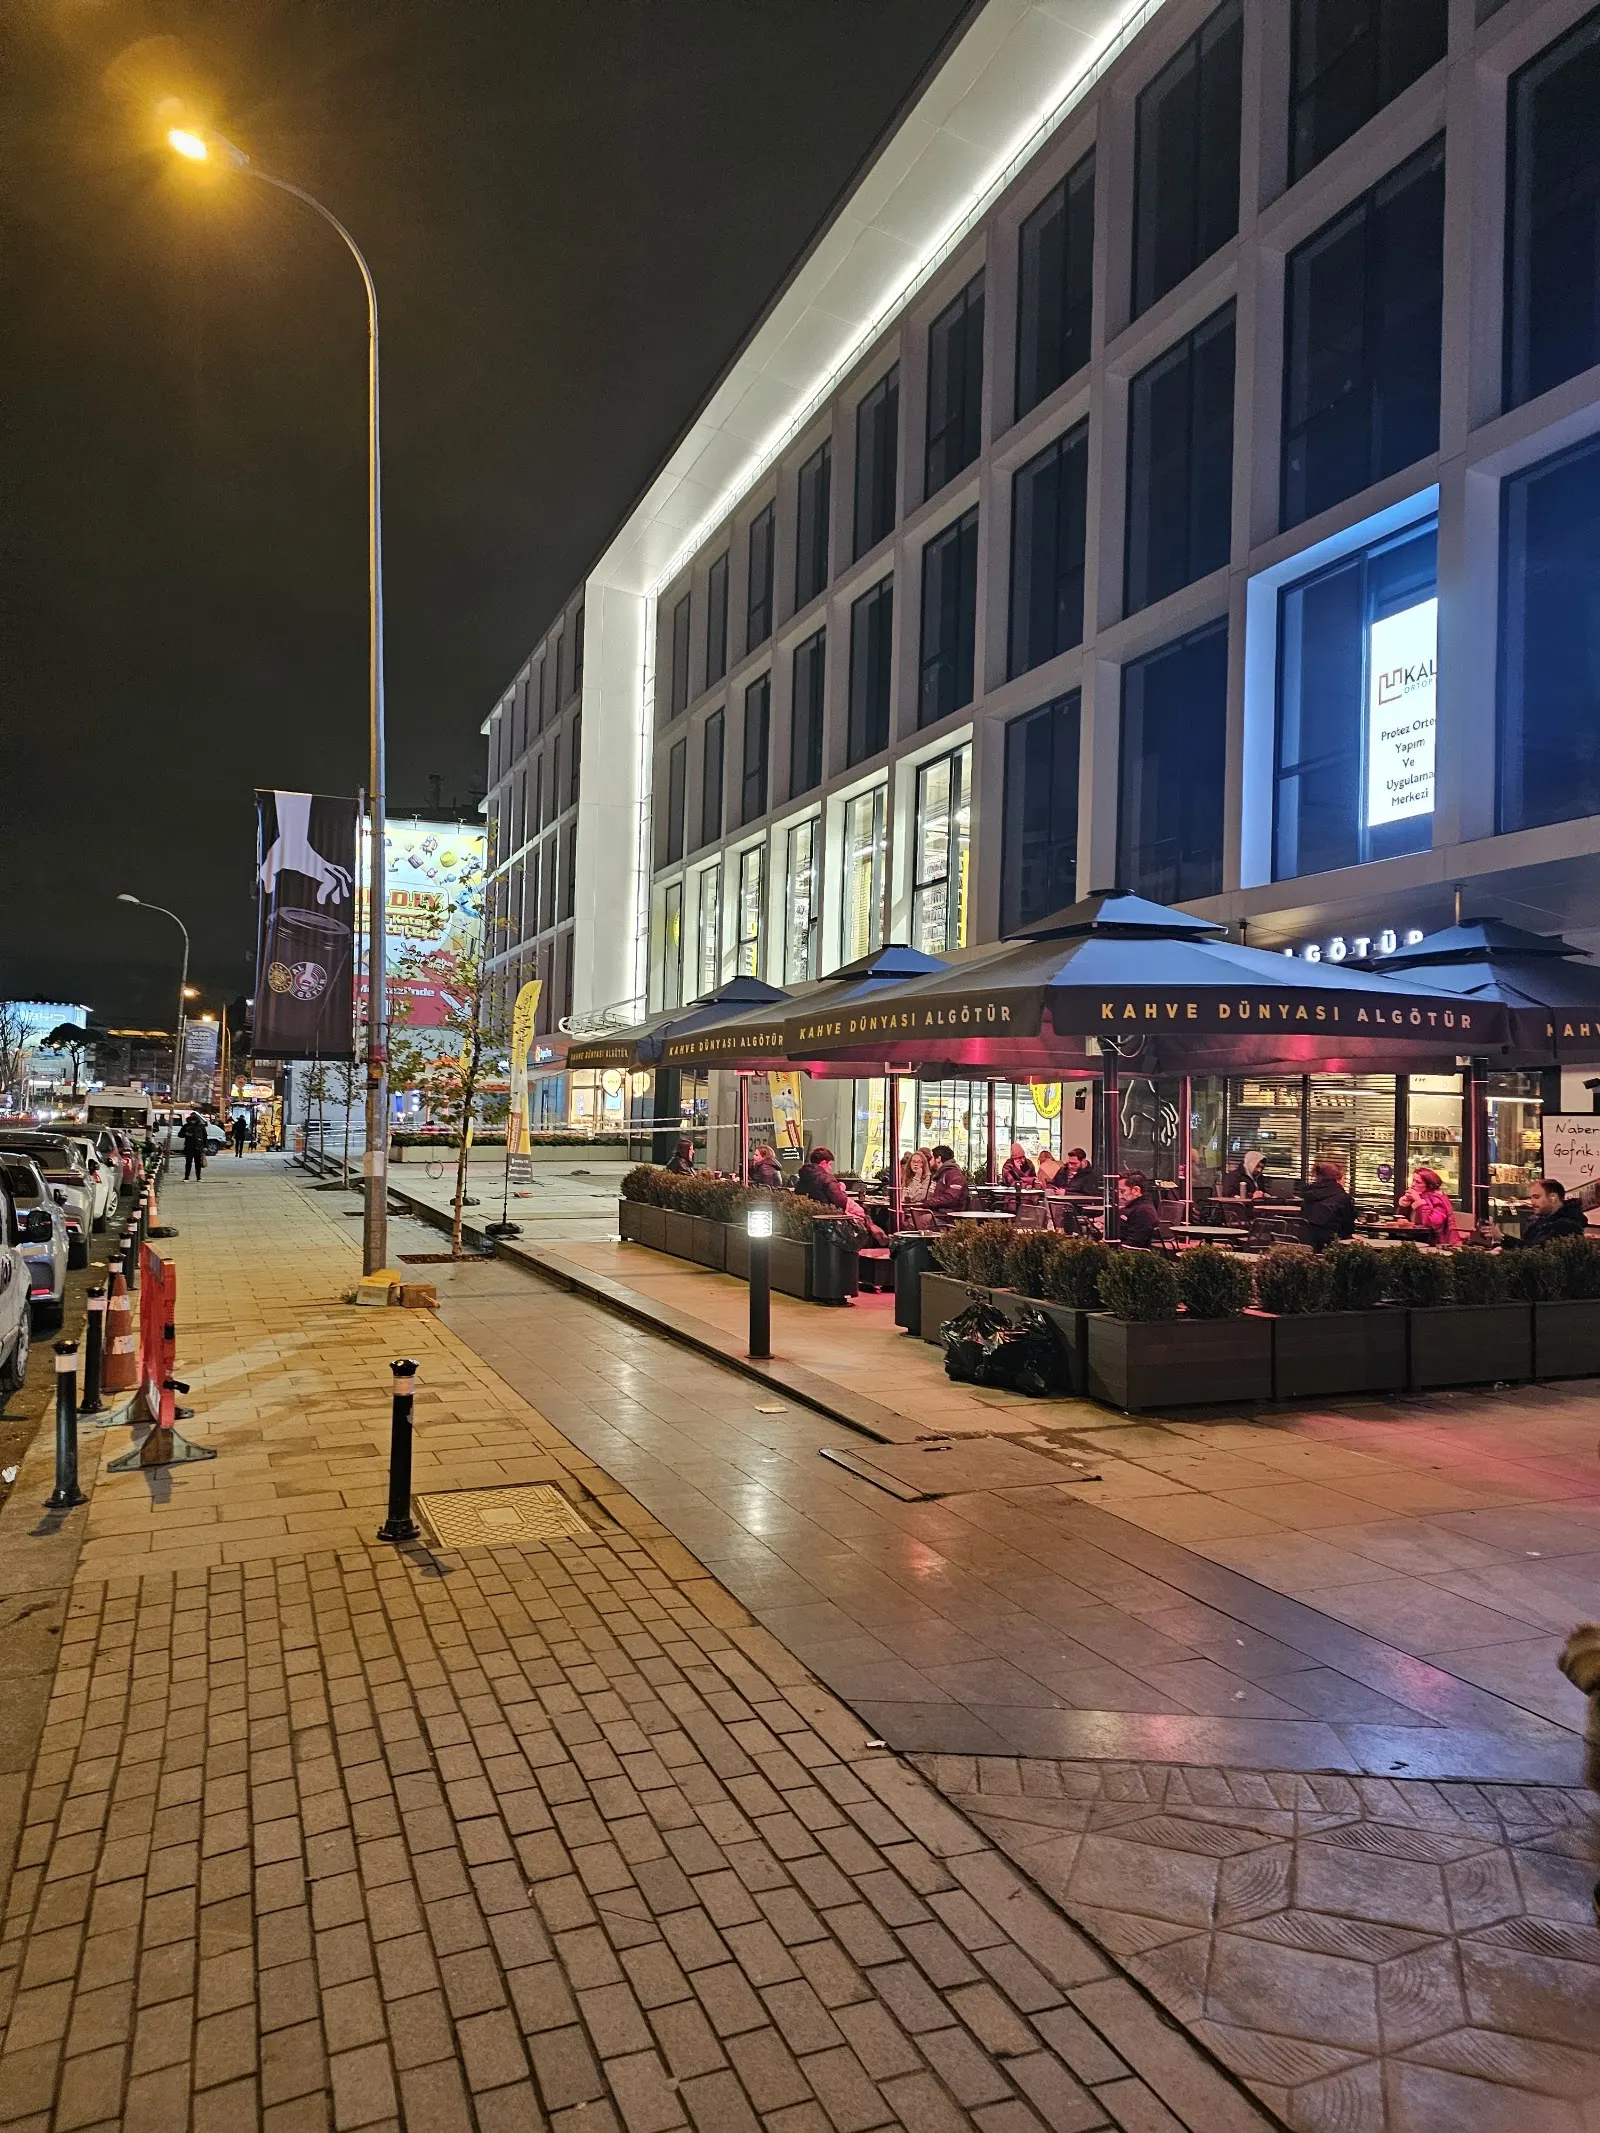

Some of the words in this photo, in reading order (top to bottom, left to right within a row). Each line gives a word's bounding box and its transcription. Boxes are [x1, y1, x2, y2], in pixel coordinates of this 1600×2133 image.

[1381, 725, 1410, 741] Protez
[1395, 738, 1425, 754] Yapım
[1402, 758, 1415, 768] Ve
[1392, 787, 1429, 806] Merkezi
[1284, 929, 1424, 963] GÖTÜR
[291, 965, 305, 975] AL
[799, 1022, 842, 1040] KAHVE
[850, 1012, 916, 1033] DÜNYASI
[925, 1003, 1011, 1025] ALGÖTÜR
[1101, 1003, 1198, 1019] KAHVE
[1219, 1000, 1339, 1021] DÜNYASI
[1357, 1007, 1472, 1029] ALGÖTÜR
[668, 1043, 695, 1056] KAHVE
[699, 1037, 737, 1052] DÜNYASI
[741, 1032, 784, 1048] ALGÖTÜR
